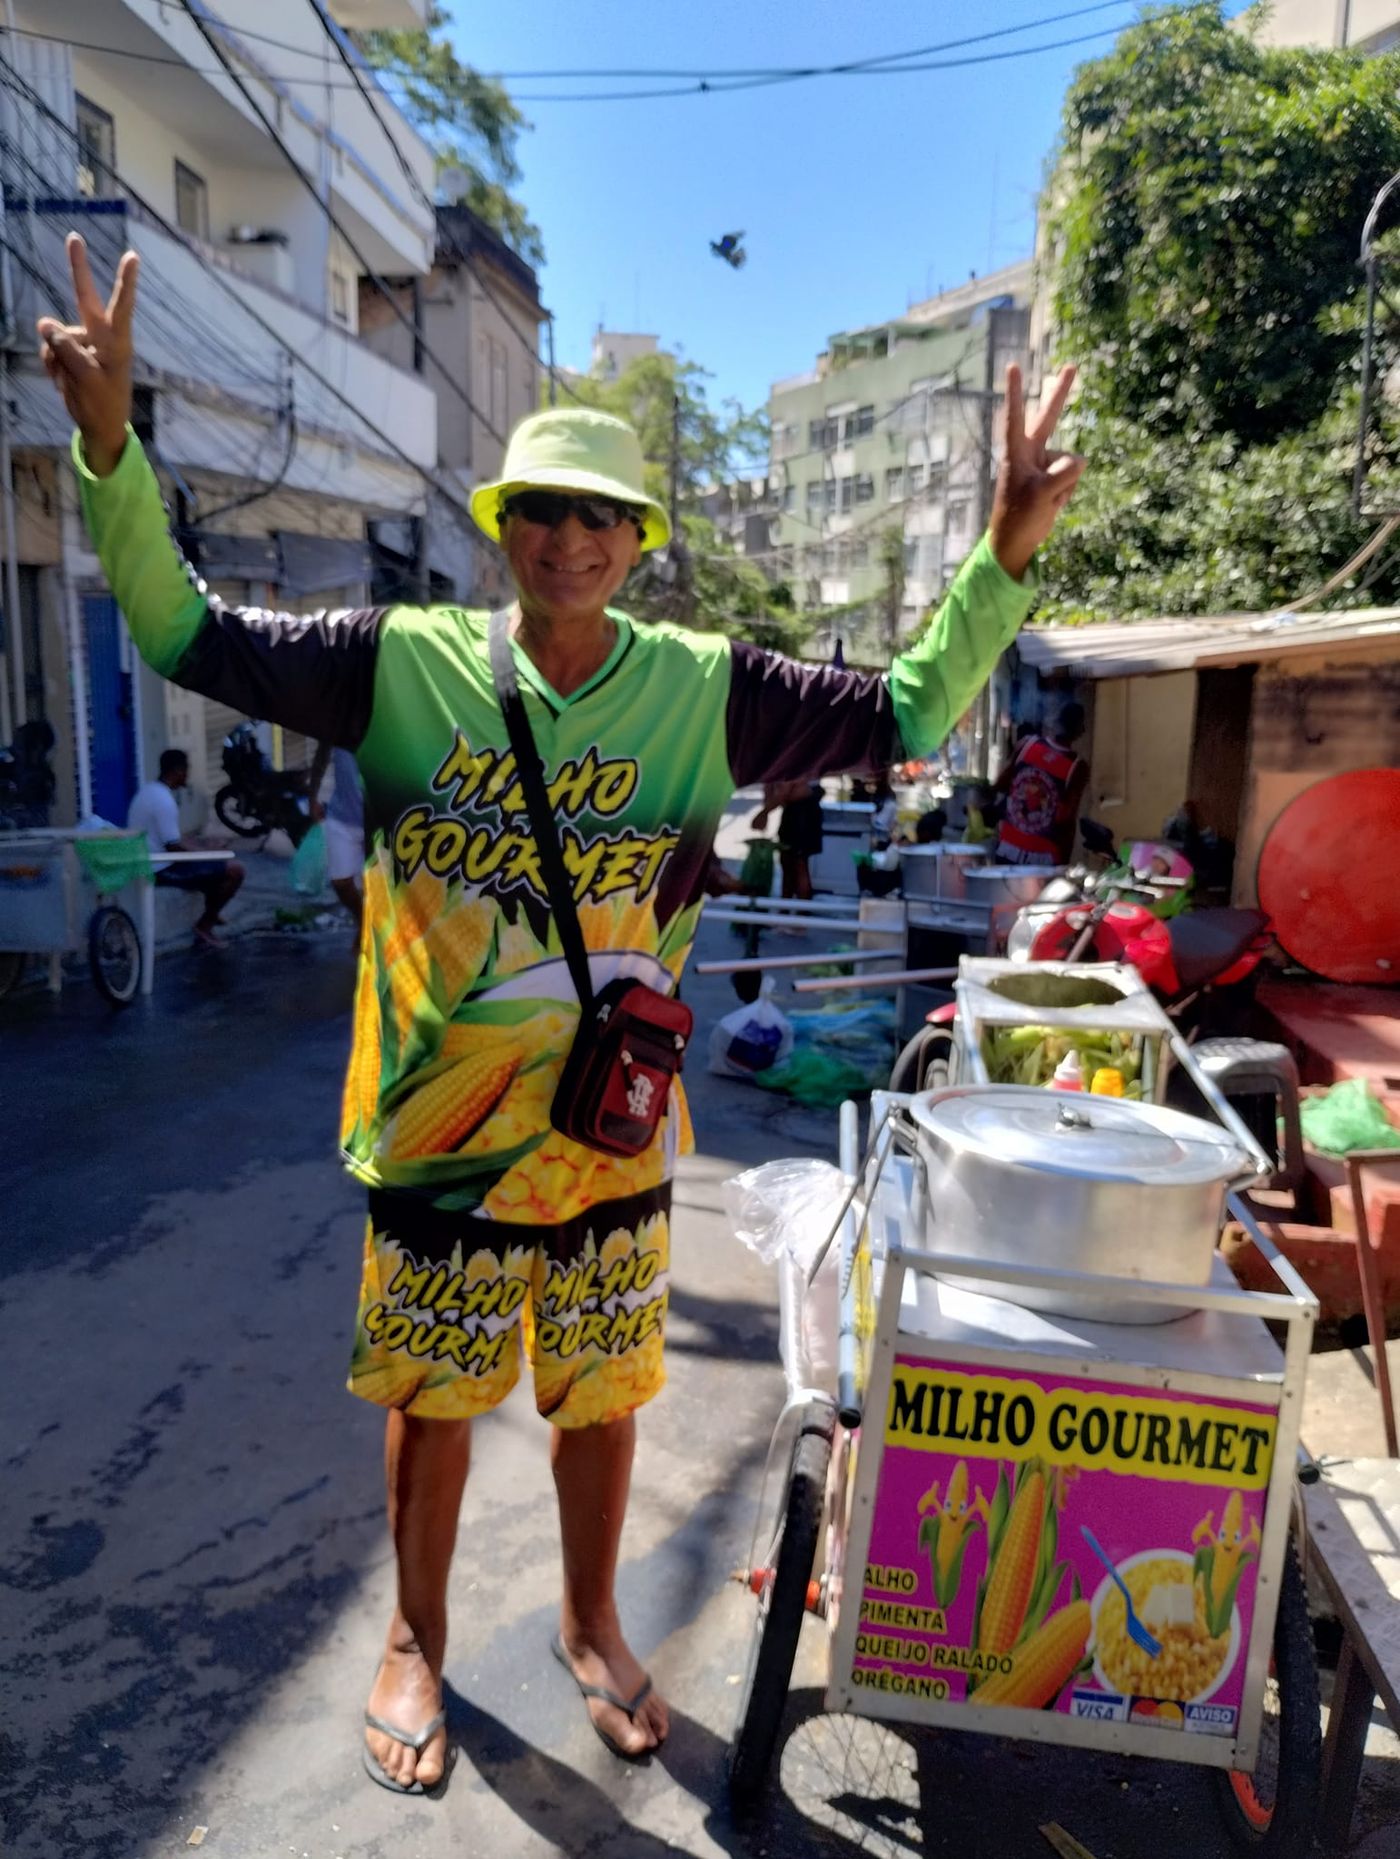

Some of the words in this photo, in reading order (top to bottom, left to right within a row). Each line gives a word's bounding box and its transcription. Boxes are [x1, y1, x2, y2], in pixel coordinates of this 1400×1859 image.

[389, 1253, 529, 1318] MILHO
[543, 1248, 660, 1315] MILHO
[889, 1379, 1036, 1446] MILHO
[1048, 1402, 1270, 1476] GOURMET
[865, 1567, 914, 1591] ALHO
[860, 1602, 944, 1630] PIMENTA
[855, 1636, 927, 1662] QUEIJO
[933, 1647, 1013, 1674] RALADO
[1076, 1702, 1115, 1720] VISA
[1189, 1706, 1232, 1722] AVISO
